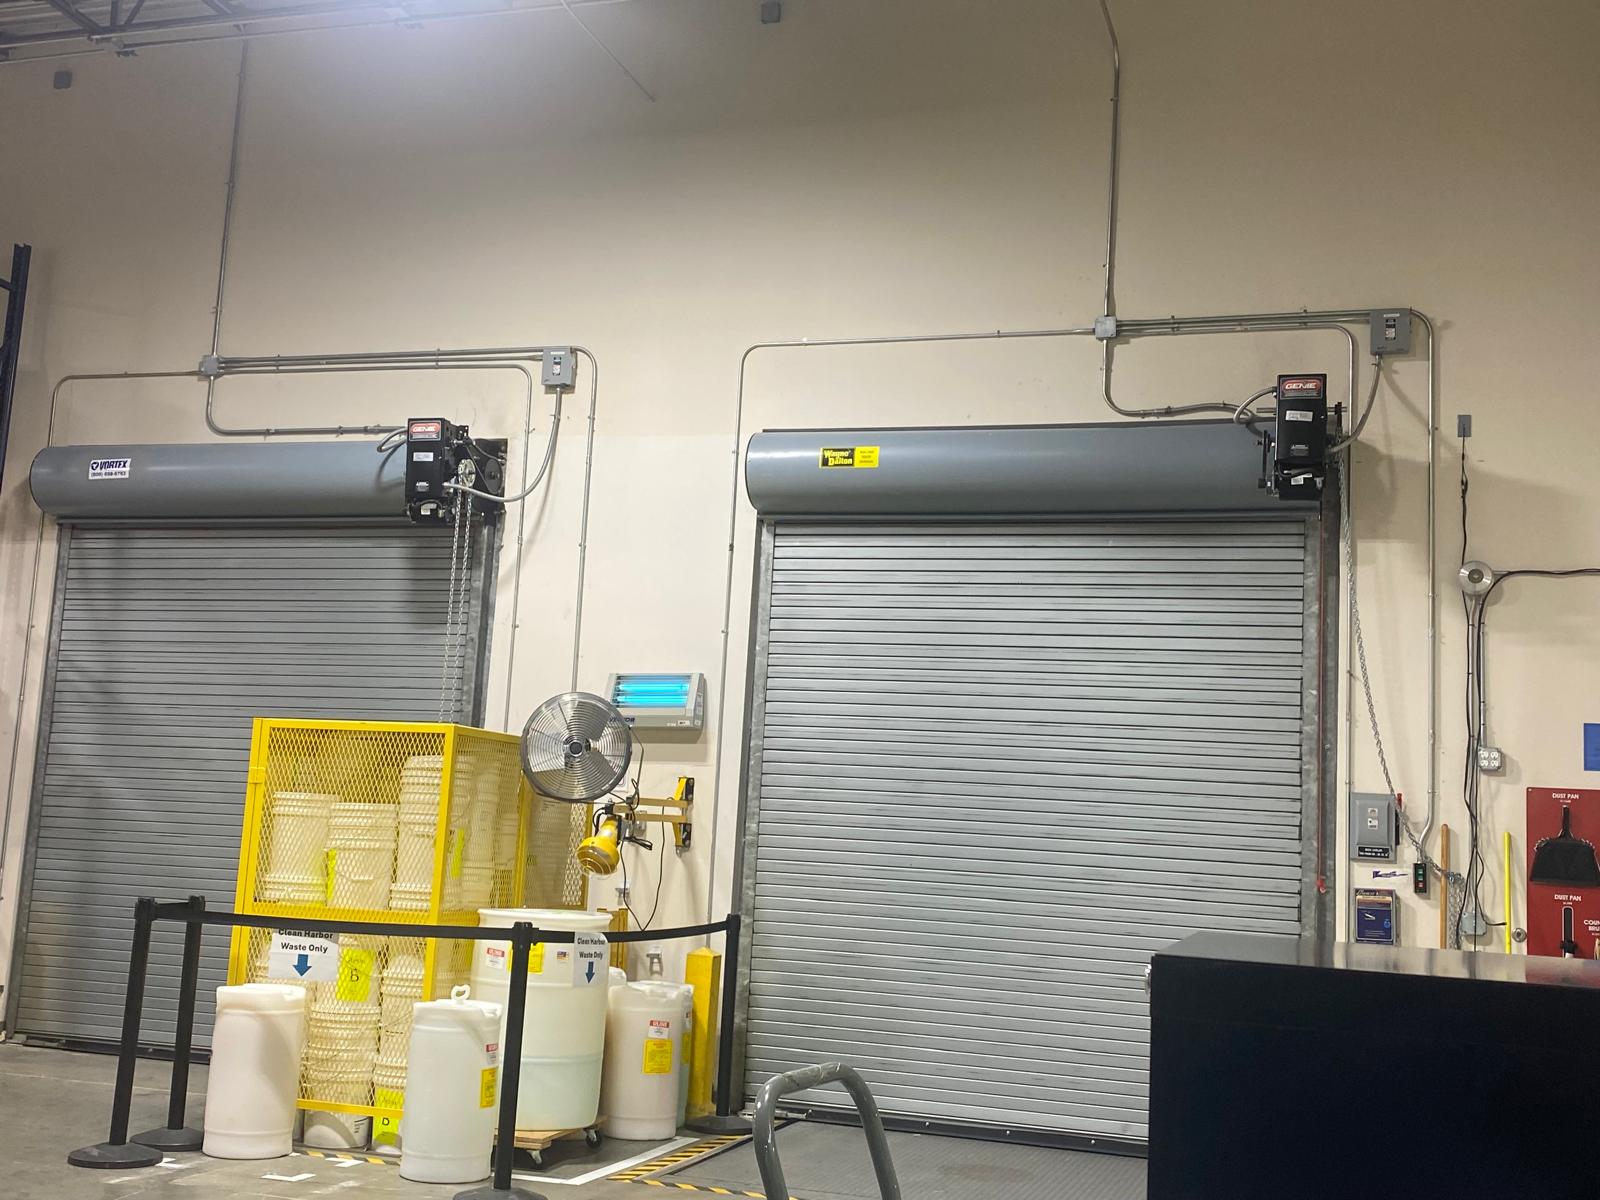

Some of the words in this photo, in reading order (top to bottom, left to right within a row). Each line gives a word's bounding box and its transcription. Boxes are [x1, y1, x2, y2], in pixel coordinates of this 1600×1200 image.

[100, 460, 128, 470] VORTEX
[829, 458, 853, 466] Dalton
[279, 929, 303, 937] Clean
[304, 930, 333, 939] Harbor
[578, 937, 590, 945] Clean
[281, 942, 307, 951] Waste
[309, 944, 328, 954] Only
[579, 951, 593, 959] Waste
[594, 951, 604, 960] Only
